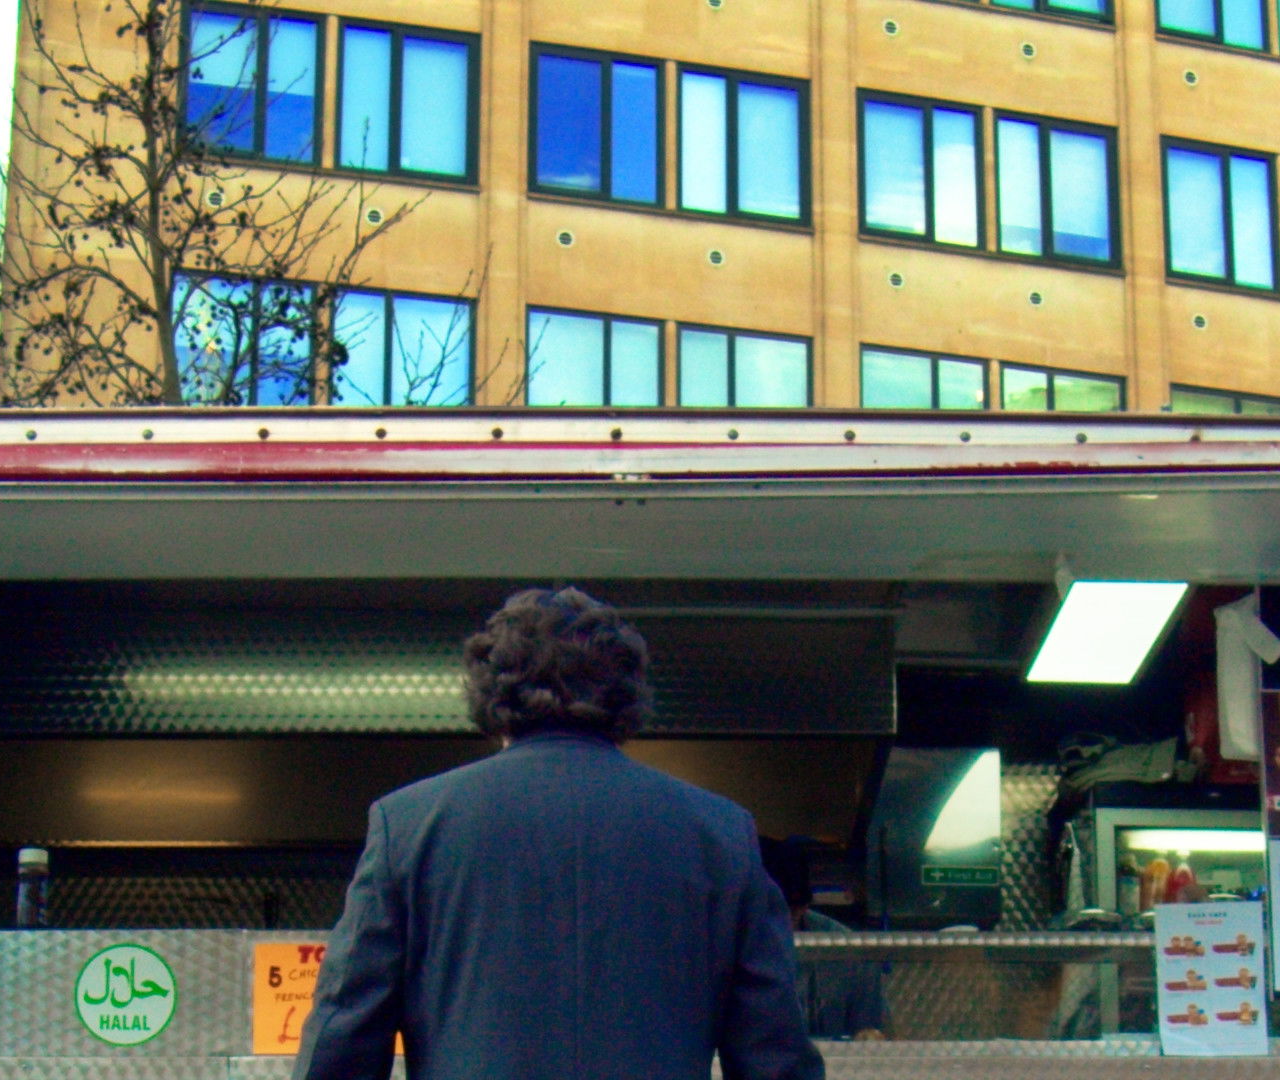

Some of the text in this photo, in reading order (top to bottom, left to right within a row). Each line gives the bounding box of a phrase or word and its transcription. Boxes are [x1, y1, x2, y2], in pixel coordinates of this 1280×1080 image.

[83, 957, 170, 1009] حلال
[268, 965, 283, 989] 5
[99, 1014, 152, 1031] HALAL
